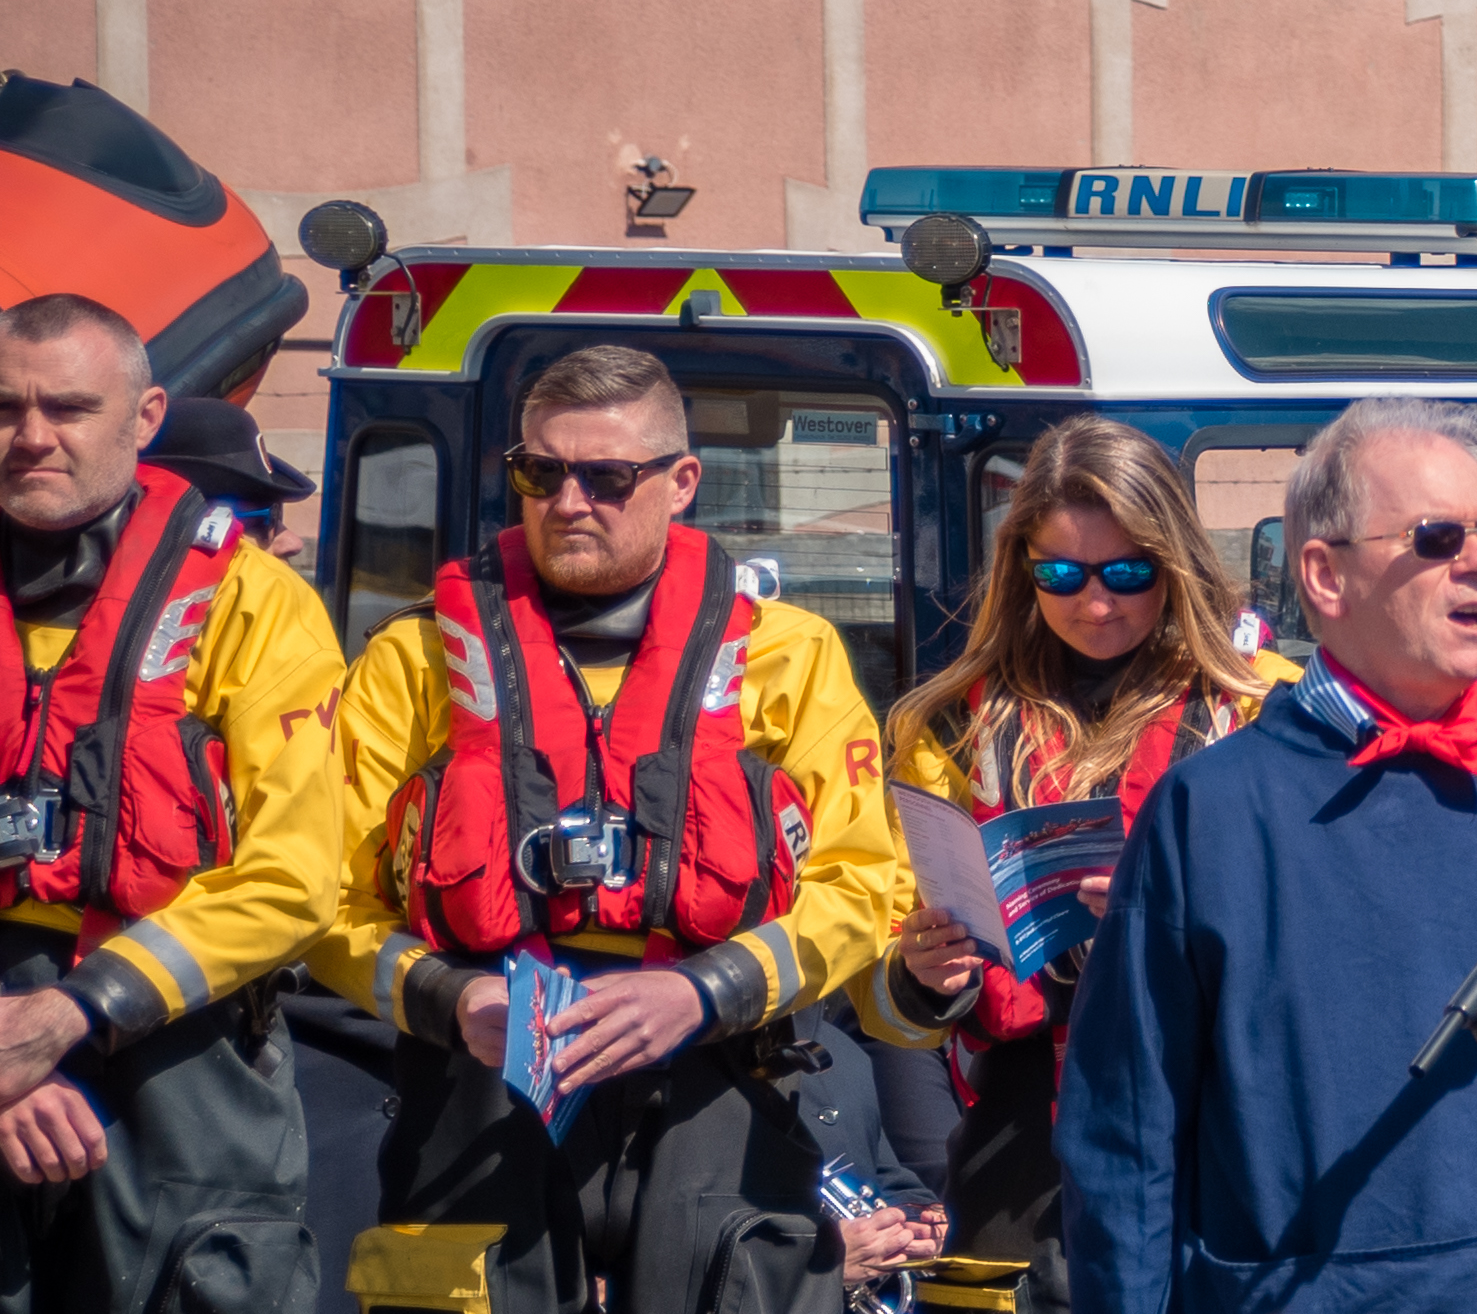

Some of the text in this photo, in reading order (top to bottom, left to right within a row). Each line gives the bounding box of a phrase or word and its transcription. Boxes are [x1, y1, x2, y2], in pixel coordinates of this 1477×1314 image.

[1075, 175, 1247, 217] RNLI
[793, 415, 873, 433] Westover
[1047, 880, 1080, 893] Dedicatio
